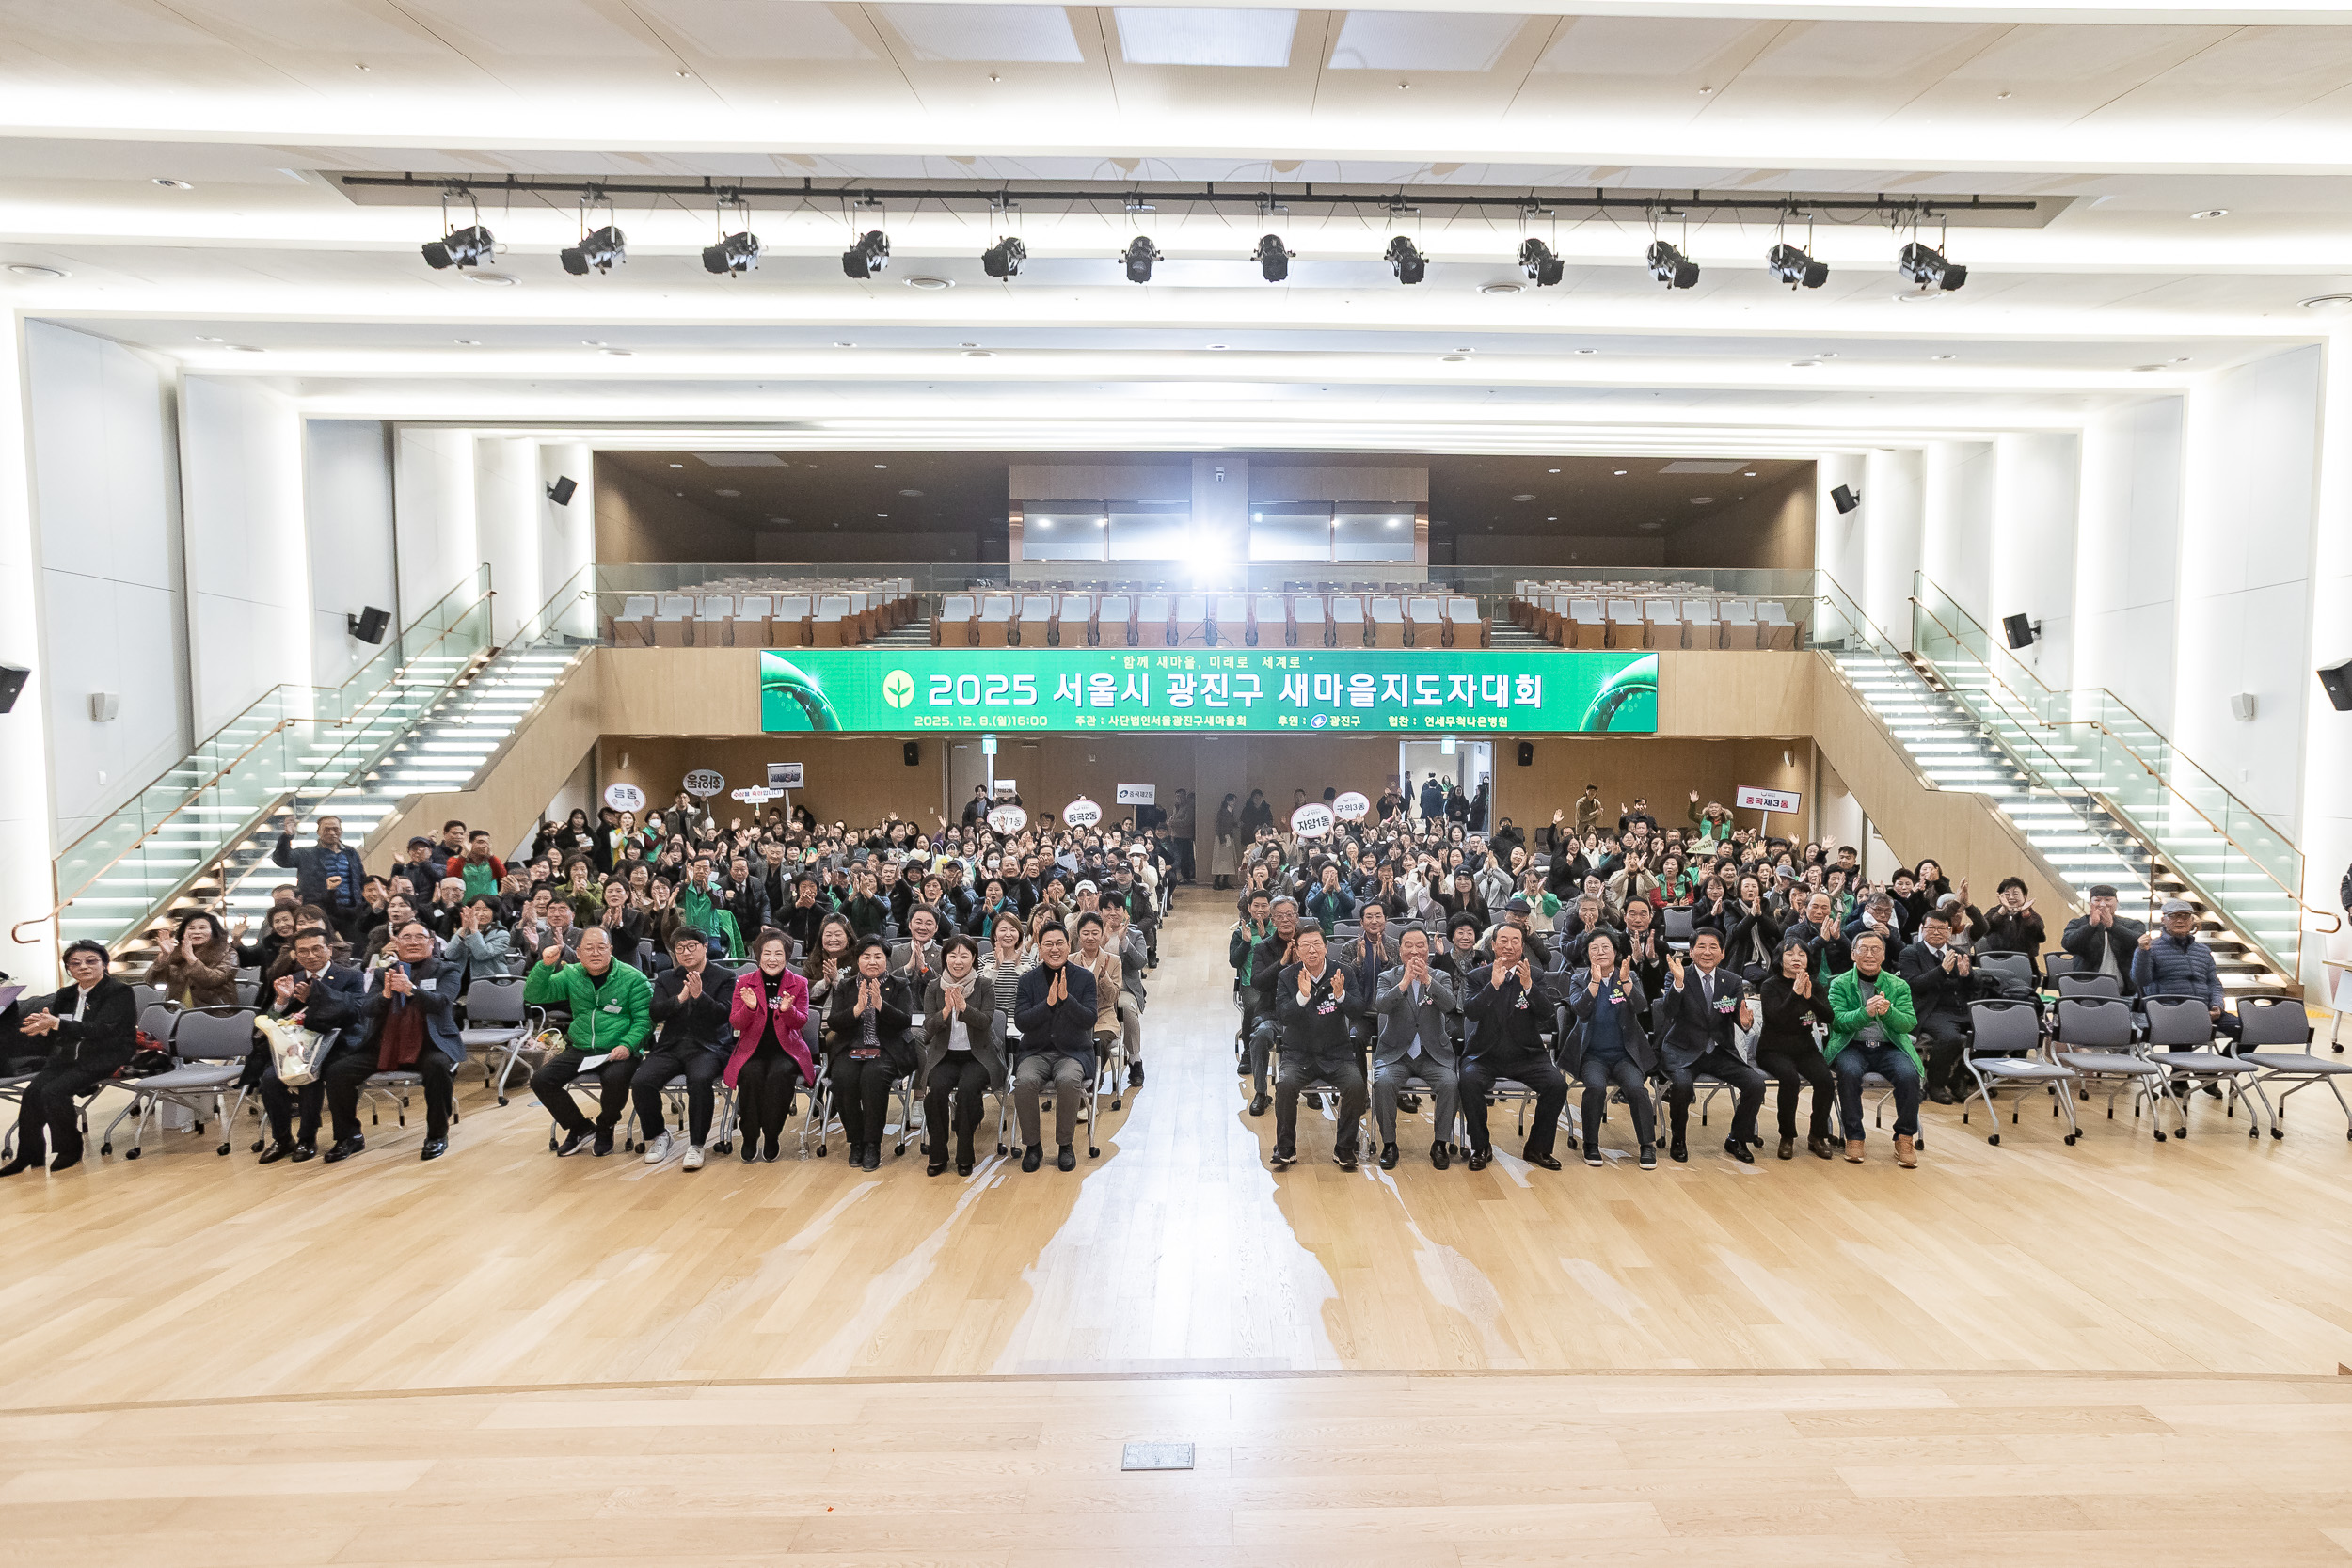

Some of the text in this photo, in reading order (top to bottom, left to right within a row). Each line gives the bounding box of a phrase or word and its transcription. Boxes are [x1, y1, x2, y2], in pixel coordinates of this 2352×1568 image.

[1123, 655, 1149, 670] 함께
[1156, 655, 1202, 670] 새마을,
[1209, 655, 1248, 670] 미래로
[1262, 655, 1301, 670] 세계로
[929, 673, 1543, 709] 2025 서울시 광진구 새마을지도자대회
[914, 715, 954, 727] 2025.
[958, 715, 976, 727] 12.
[1074, 715, 1097, 727] 주관
[1108, 715, 1247, 727] 사단법인서울광진구새마을회
[1277, 715, 1299, 727] 후원
[1329, 715, 1361, 727] 광진구
[1388, 715, 1409, 728] 협찬
[1424, 715, 1508, 728] 연세무척나은병원
[687, 774, 721, 790] 화양동
[614, 787, 637, 800] 능동
[1129, 790, 1153, 799] 중곡제2동
[1337, 802, 1365, 813] 구의3동
[1746, 796, 1789, 809] 중곡제3동
[1069, 811, 1097, 823] 중곡2동
[1297, 815, 1330, 832] 자양1동
